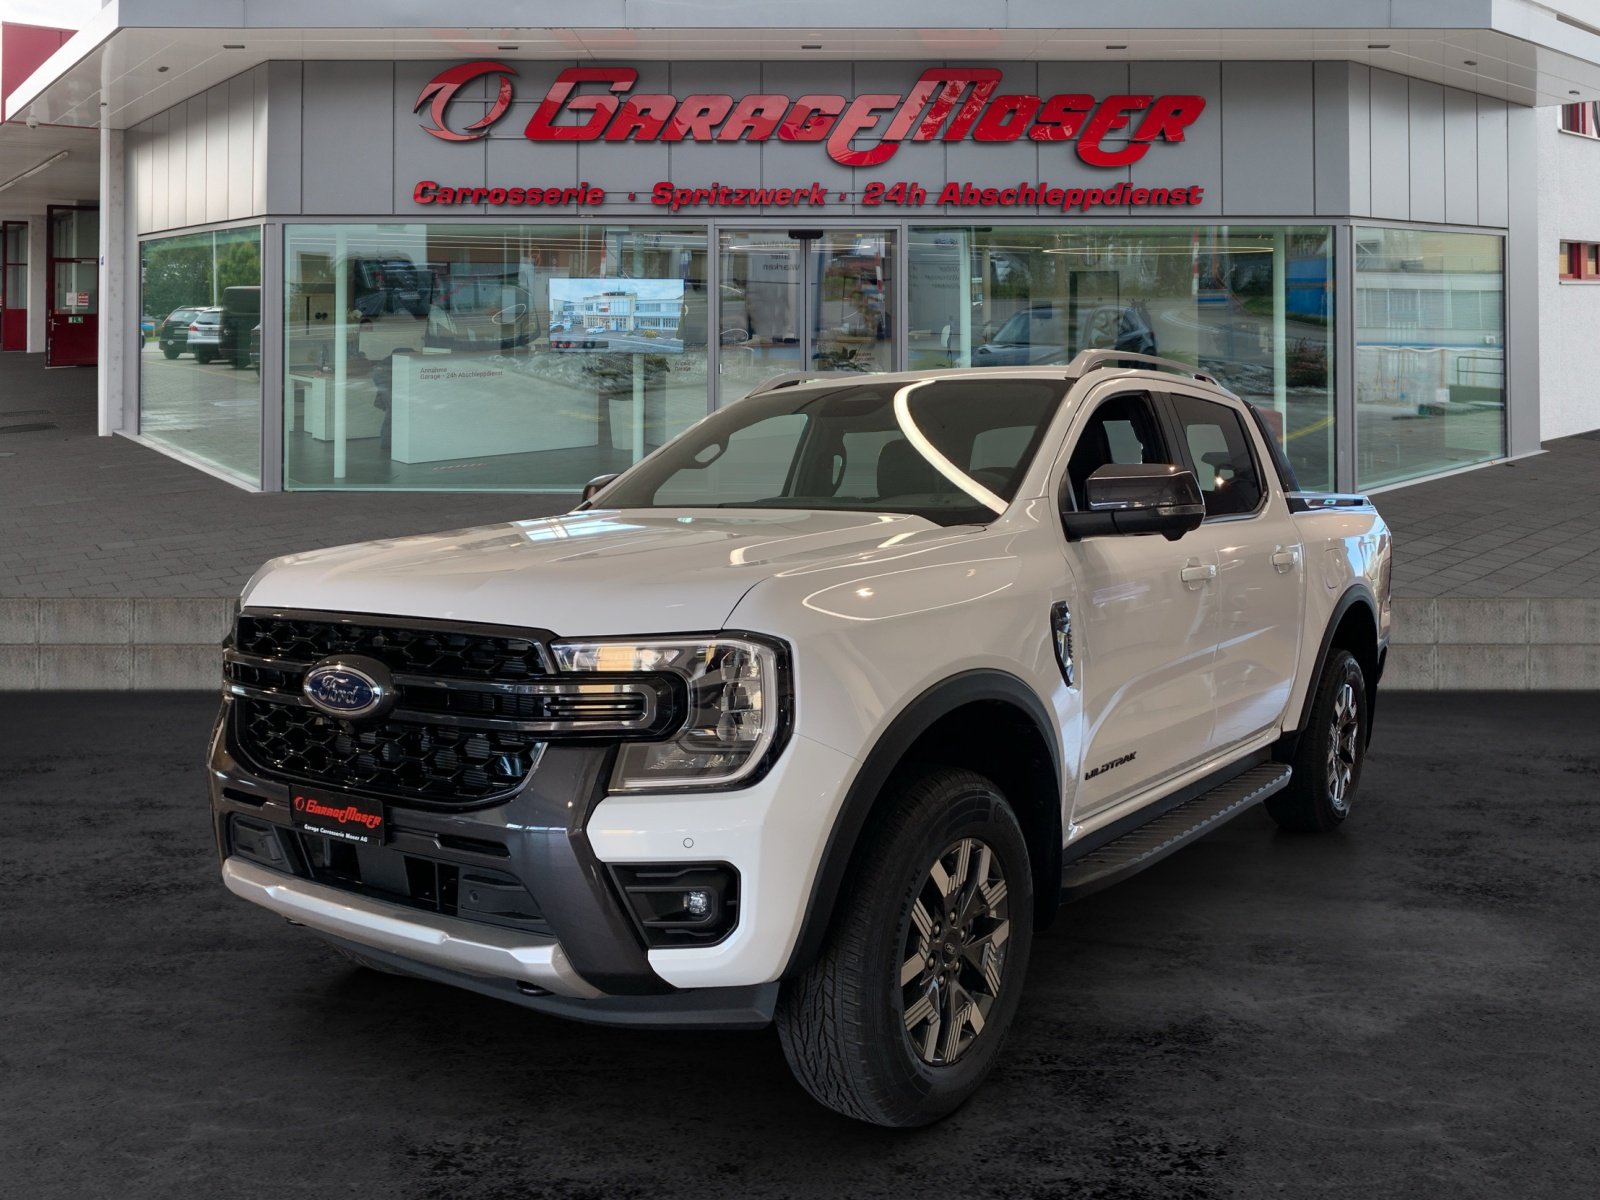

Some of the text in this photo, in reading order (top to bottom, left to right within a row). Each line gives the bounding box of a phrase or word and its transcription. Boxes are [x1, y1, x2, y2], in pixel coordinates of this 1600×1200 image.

[413, 180, 1204, 212] Carrosserie Spritzwerk 24h Abschleppdienst
[319, 676, 360, 703] Ford
[304, 823, 319, 833] Garage
[345, 832, 360, 841] Moser
